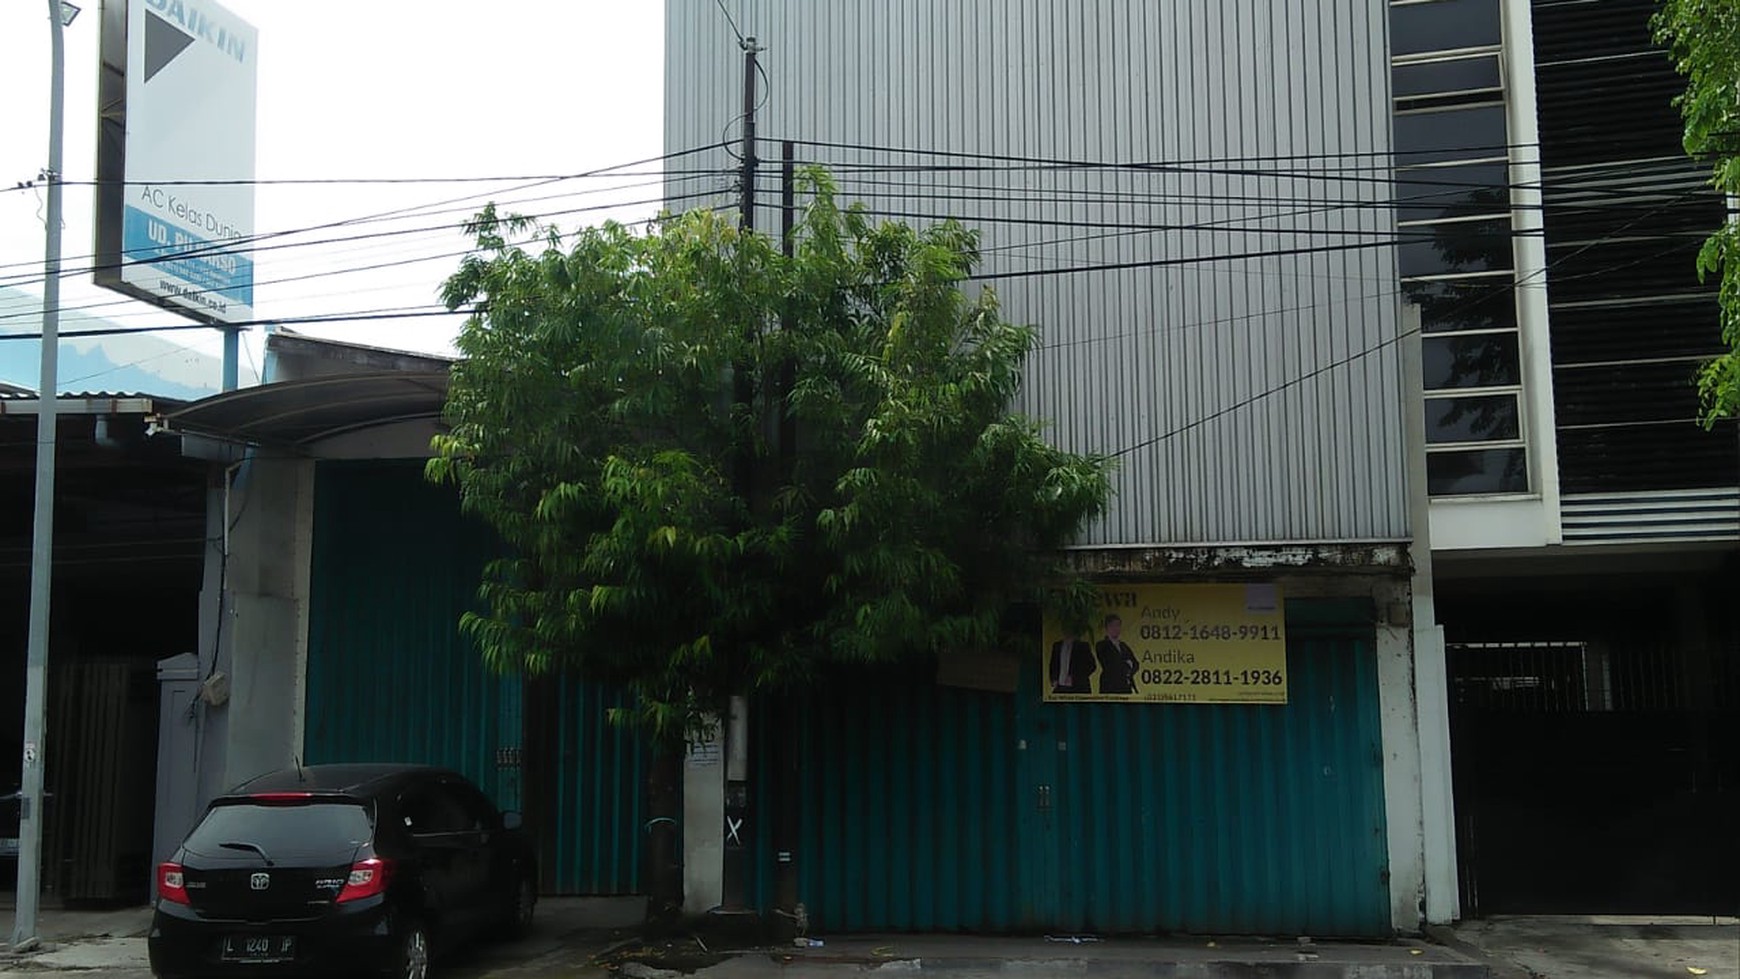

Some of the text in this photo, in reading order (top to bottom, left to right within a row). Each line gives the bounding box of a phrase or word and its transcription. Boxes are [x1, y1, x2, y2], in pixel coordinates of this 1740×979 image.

[141, 185, 242, 240] AC Kelas Dunia
[1141, 606, 1180, 623] Andy
[1140, 624, 1281, 641] 0812-1648-9911
[1142, 649, 1195, 664] Andika
[1141, 669, 1283, 686] 0822-2811-1936
[227, 937, 235, 952] L
[246, 937, 269, 952] 1240
